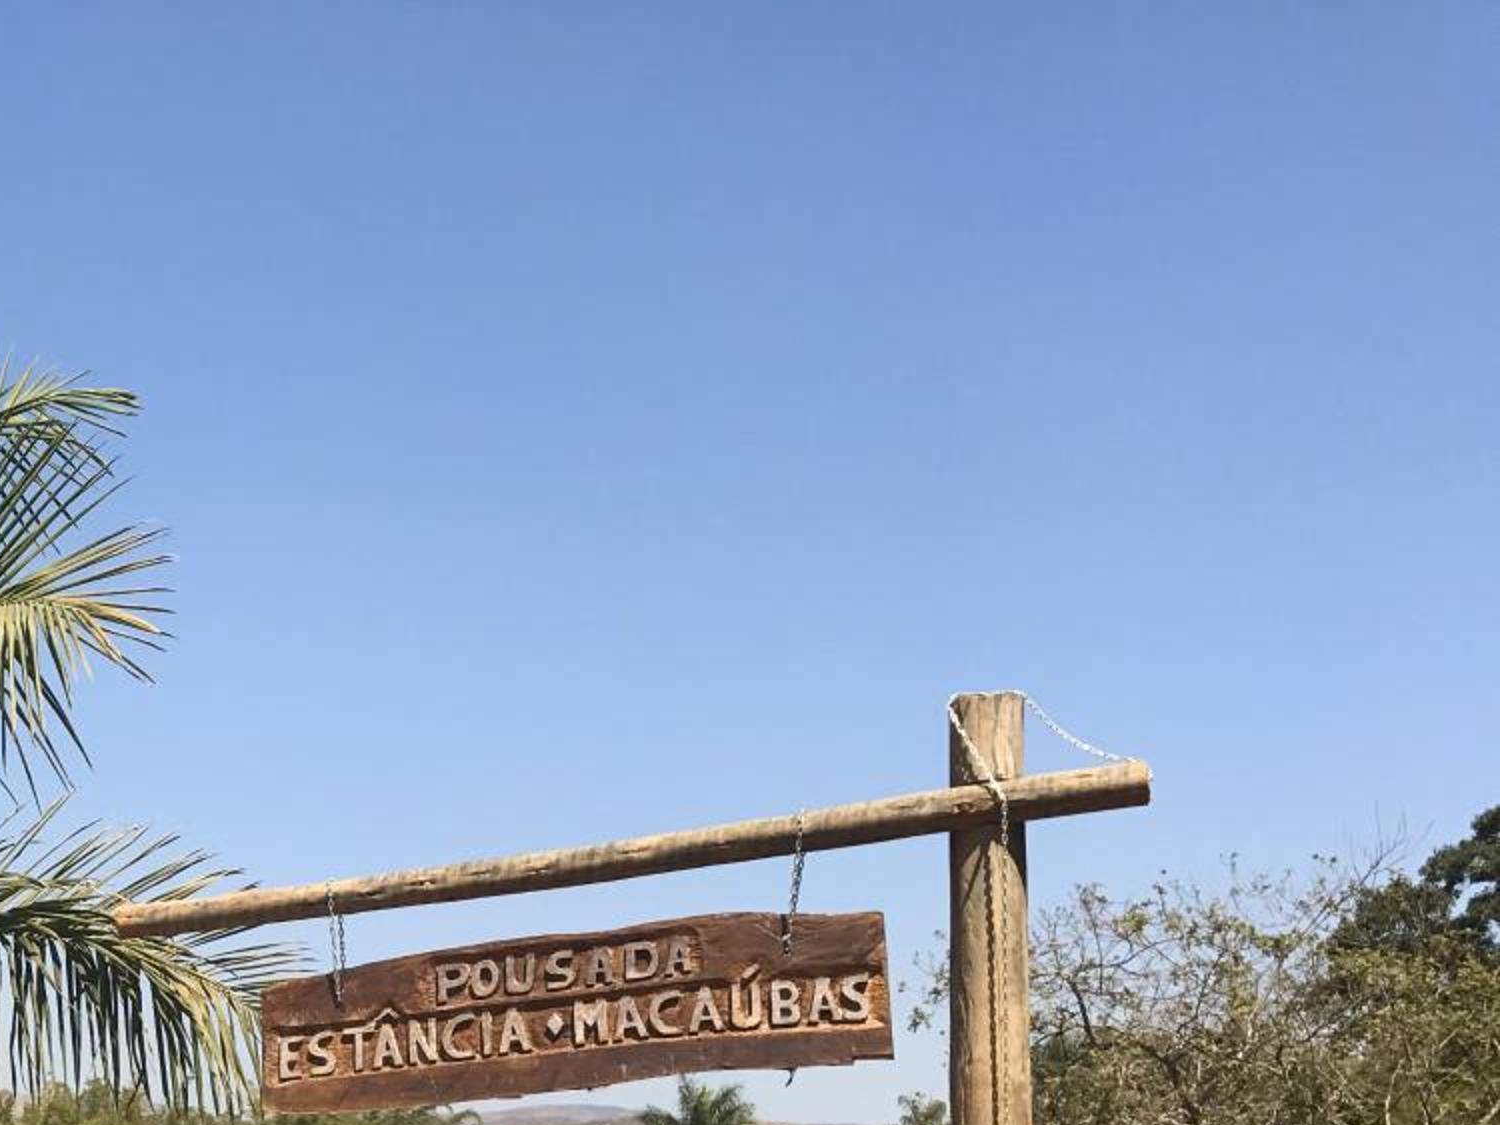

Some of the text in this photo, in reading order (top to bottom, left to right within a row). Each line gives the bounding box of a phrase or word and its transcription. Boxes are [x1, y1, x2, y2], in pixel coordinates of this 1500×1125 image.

[435, 937, 693, 1005] POUSADA
[278, 963, 873, 1081] ESTÂNCIA MACAÚBAS
